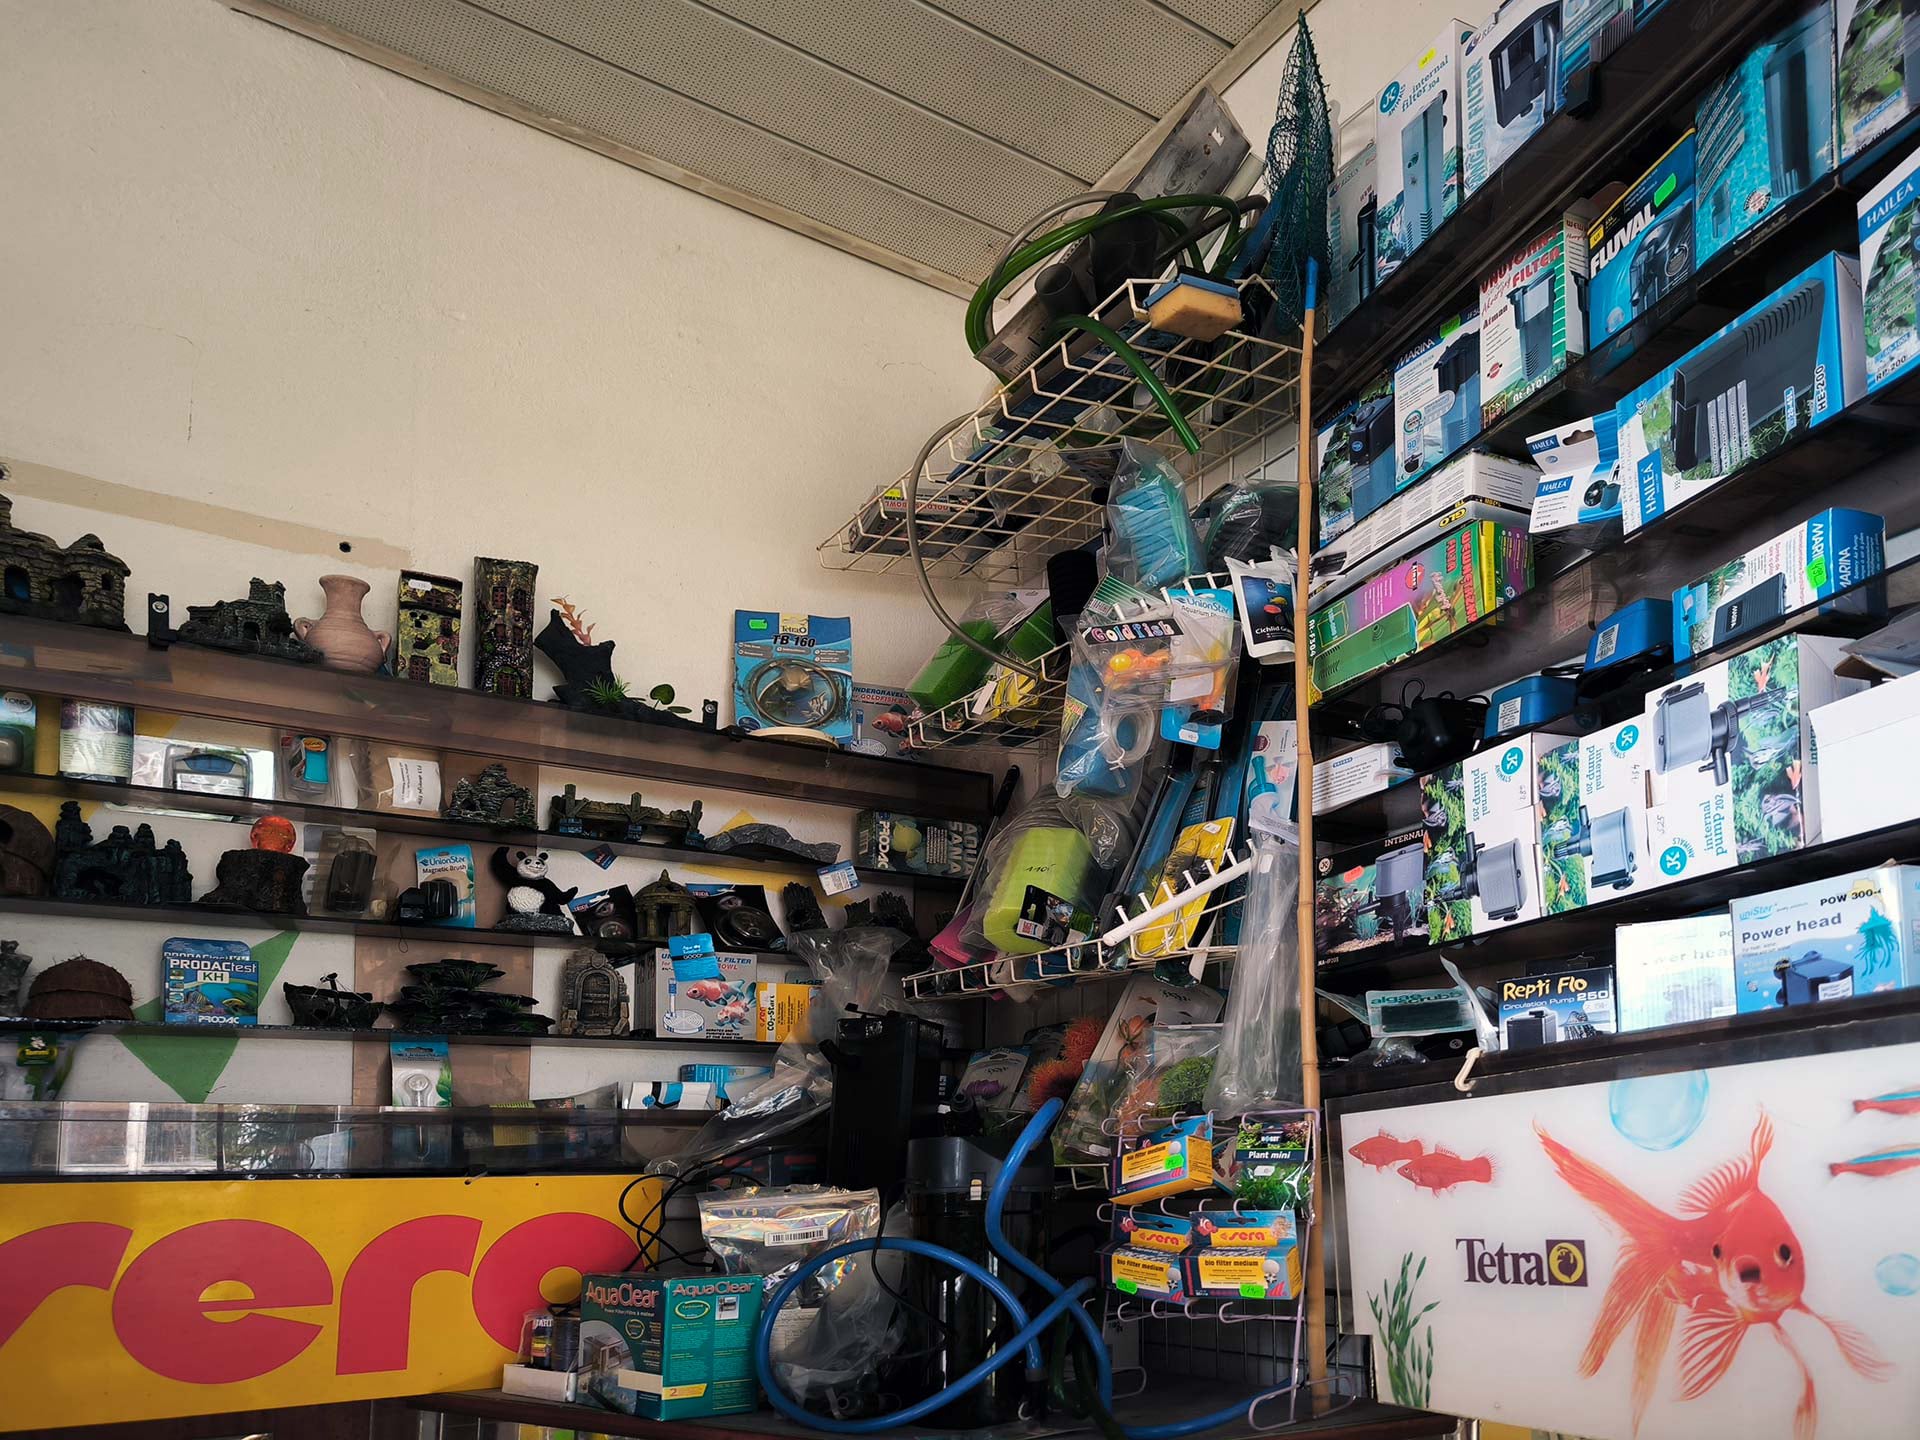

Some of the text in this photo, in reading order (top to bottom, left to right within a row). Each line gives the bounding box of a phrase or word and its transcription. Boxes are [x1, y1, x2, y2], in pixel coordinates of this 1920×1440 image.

[1412, 55, 1449, 93] internal
[1402, 86, 1431, 112] filter
[1466, 56, 1484, 119] FILTER
[1867, 182, 1914, 228] HAILEA
[1590, 202, 1656, 279] FLUVAL
[1512, 246, 1560, 288] FILTER
[1483, 305, 1508, 330] Atman
[1396, 338, 1436, 369] MARINA
[1815, 365, 1827, 412] HE-200
[1542, 481, 1567, 492] HAILEA
[1645, 462, 1657, 515] HAILEA
[1439, 508, 1467, 528] GLO
[1812, 523, 1824, 561] MARI
[773, 634, 816, 648] TB 160
[782, 625, 800, 634] Tetra
[1091, 620, 1175, 643] Goldfish
[1586, 745, 1595, 780] pump
[1595, 748, 1605, 791] internal
[1471, 768, 1480, 805] pump
[1480, 771, 1491, 816] internal
[1699, 800, 1714, 852] internal
[1713, 813, 1728, 856] pump
[877, 820, 891, 869] PRODAC
[422, 864, 467, 874] Magnetic Brush
[429, 856, 466, 866] UnionStar
[1820, 894, 1847, 907] POW
[1742, 912, 1842, 944] Power head
[169, 959, 257, 973] PRODACtest
[723, 956, 752, 965] FILTER
[203, 972, 224, 982] KH
[1503, 975, 1588, 1002] Repti Flo
[1502, 989, 1609, 1011] Circulation Pump 250
[198, 1015, 240, 1024] PRODAC
[1248, 1150, 1291, 1159] Plant mini
[1147, 1233, 1180, 1246] sera
[1228, 1231, 1266, 1241] sera
[1456, 1238, 1547, 1287] Tetra
[586, 1280, 660, 1309] AquaClear
[672, 1281, 755, 1298] AquaClear
[670, 1388, 678, 1397] 2
